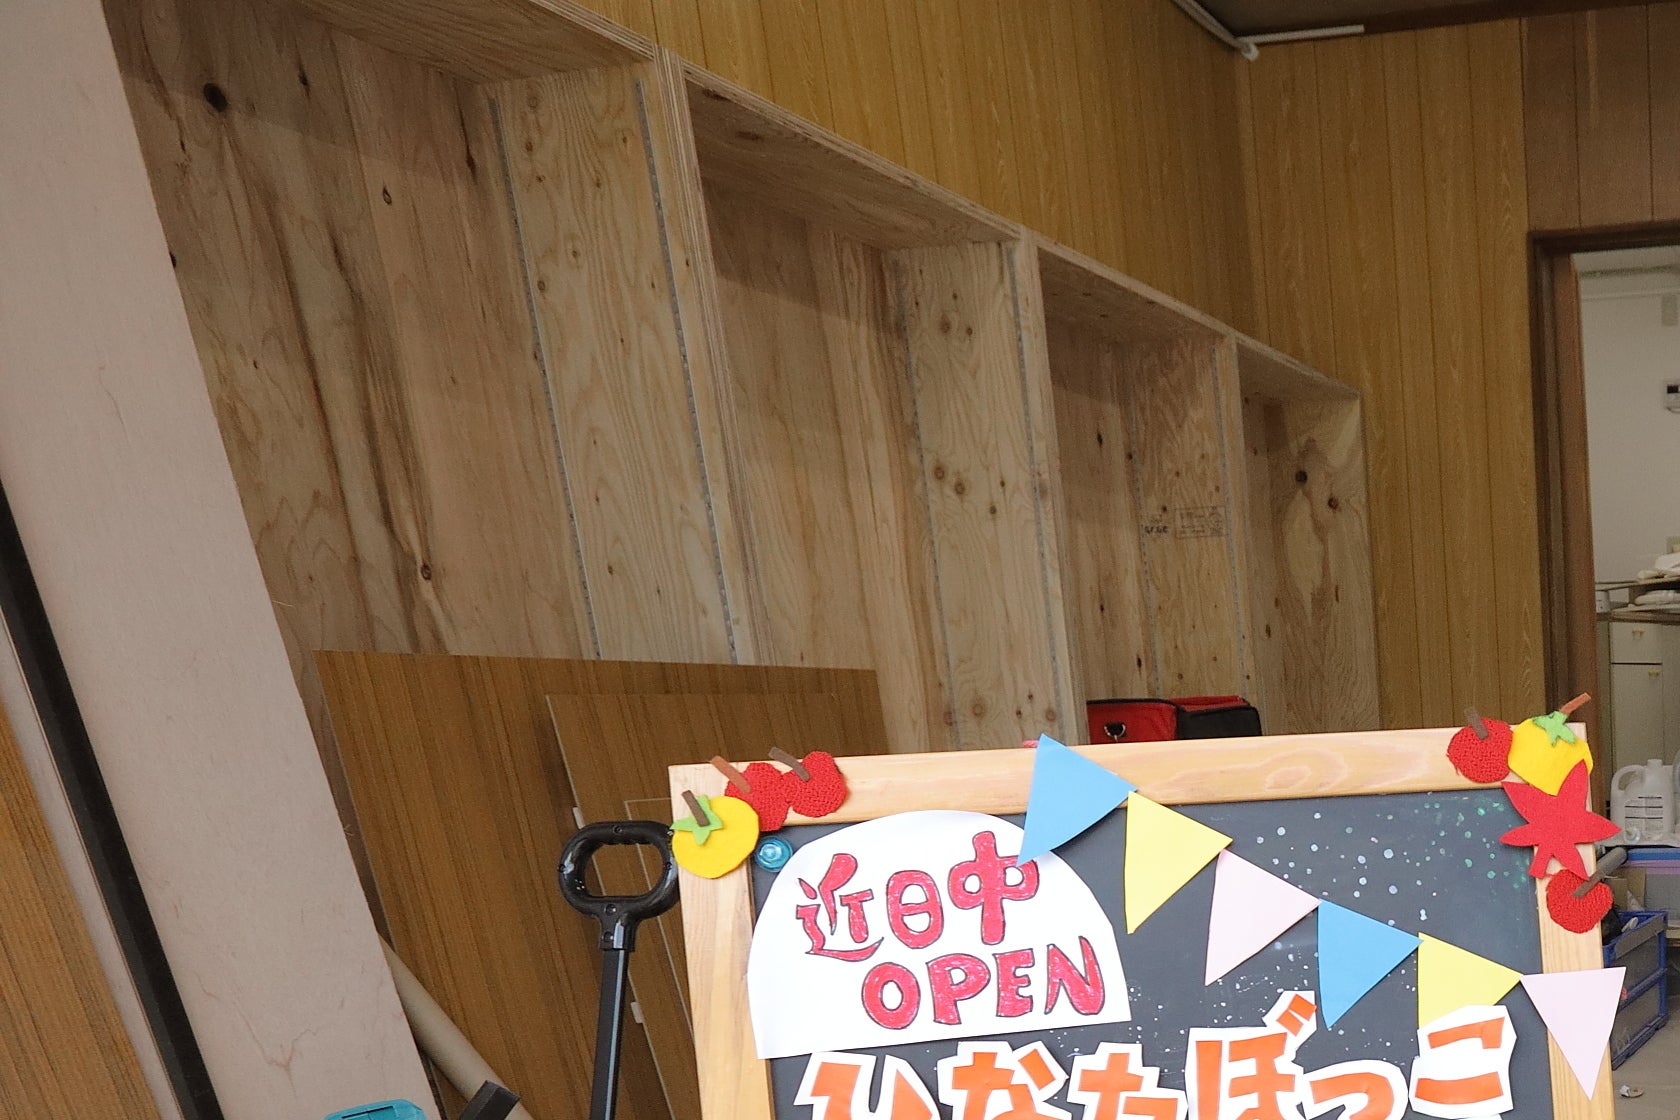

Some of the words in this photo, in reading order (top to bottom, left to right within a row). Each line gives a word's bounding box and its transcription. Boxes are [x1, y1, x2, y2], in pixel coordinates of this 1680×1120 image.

[796, 832, 1040, 962] 近日中
[862, 937, 1105, 1030] OPEN
